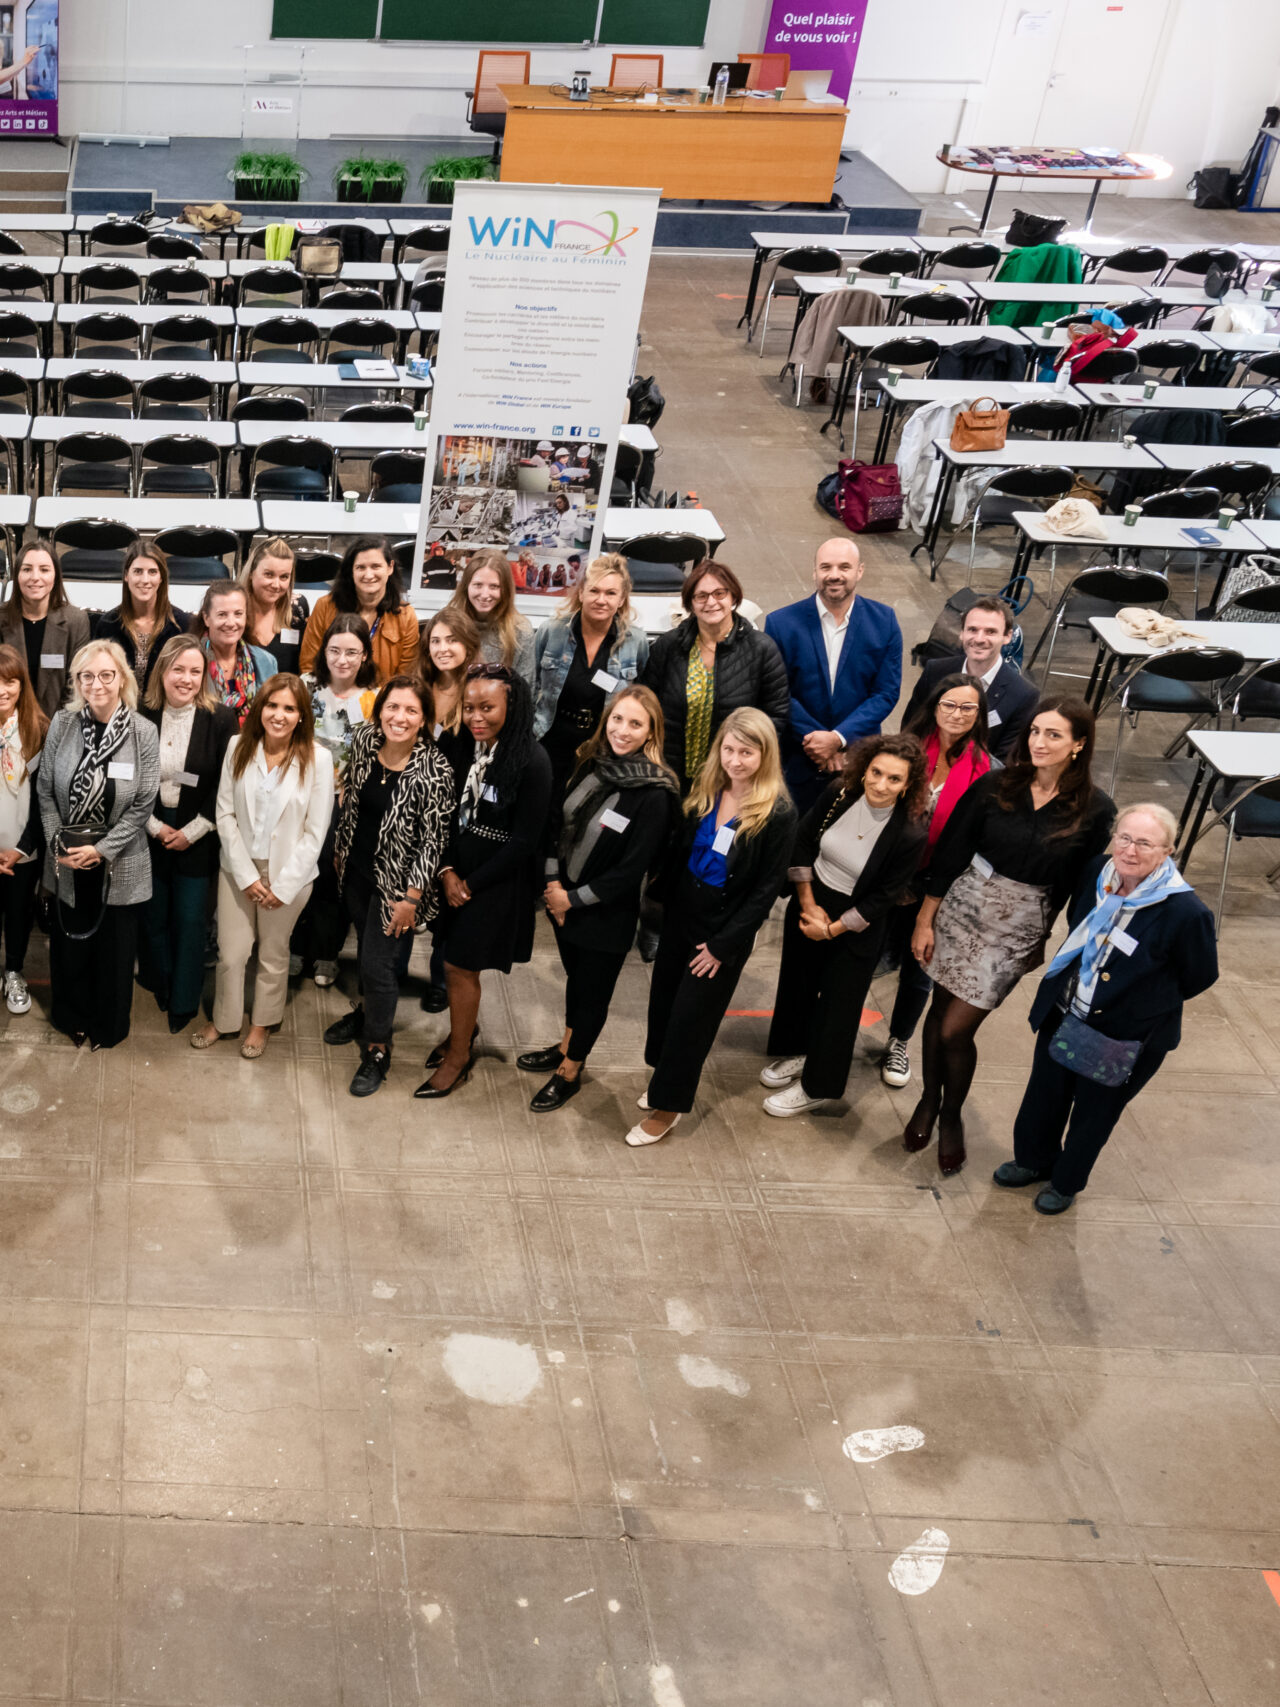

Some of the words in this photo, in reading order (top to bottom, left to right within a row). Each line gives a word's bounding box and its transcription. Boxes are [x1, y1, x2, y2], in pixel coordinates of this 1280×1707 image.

[783, 12, 813, 27] Quel
[814, 12, 855, 28] plaisir
[775, 30, 791, 42] de
[793, 33, 823, 43] vous
[825, 31, 850, 43] voir
[852, 31, 857, 43] !
[468, 216, 556, 249] WiN
[554, 242, 591, 251] FRANCE
[465, 252, 480, 260] Le
[484, 252, 548, 263] Nucléaire
[552, 255, 568, 264] au
[573, 255, 627, 266] Féminin
[529, 304, 558, 312] objectifs
[523, 361, 547, 369] actions
[453, 422, 536, 434] www.win-france.org
